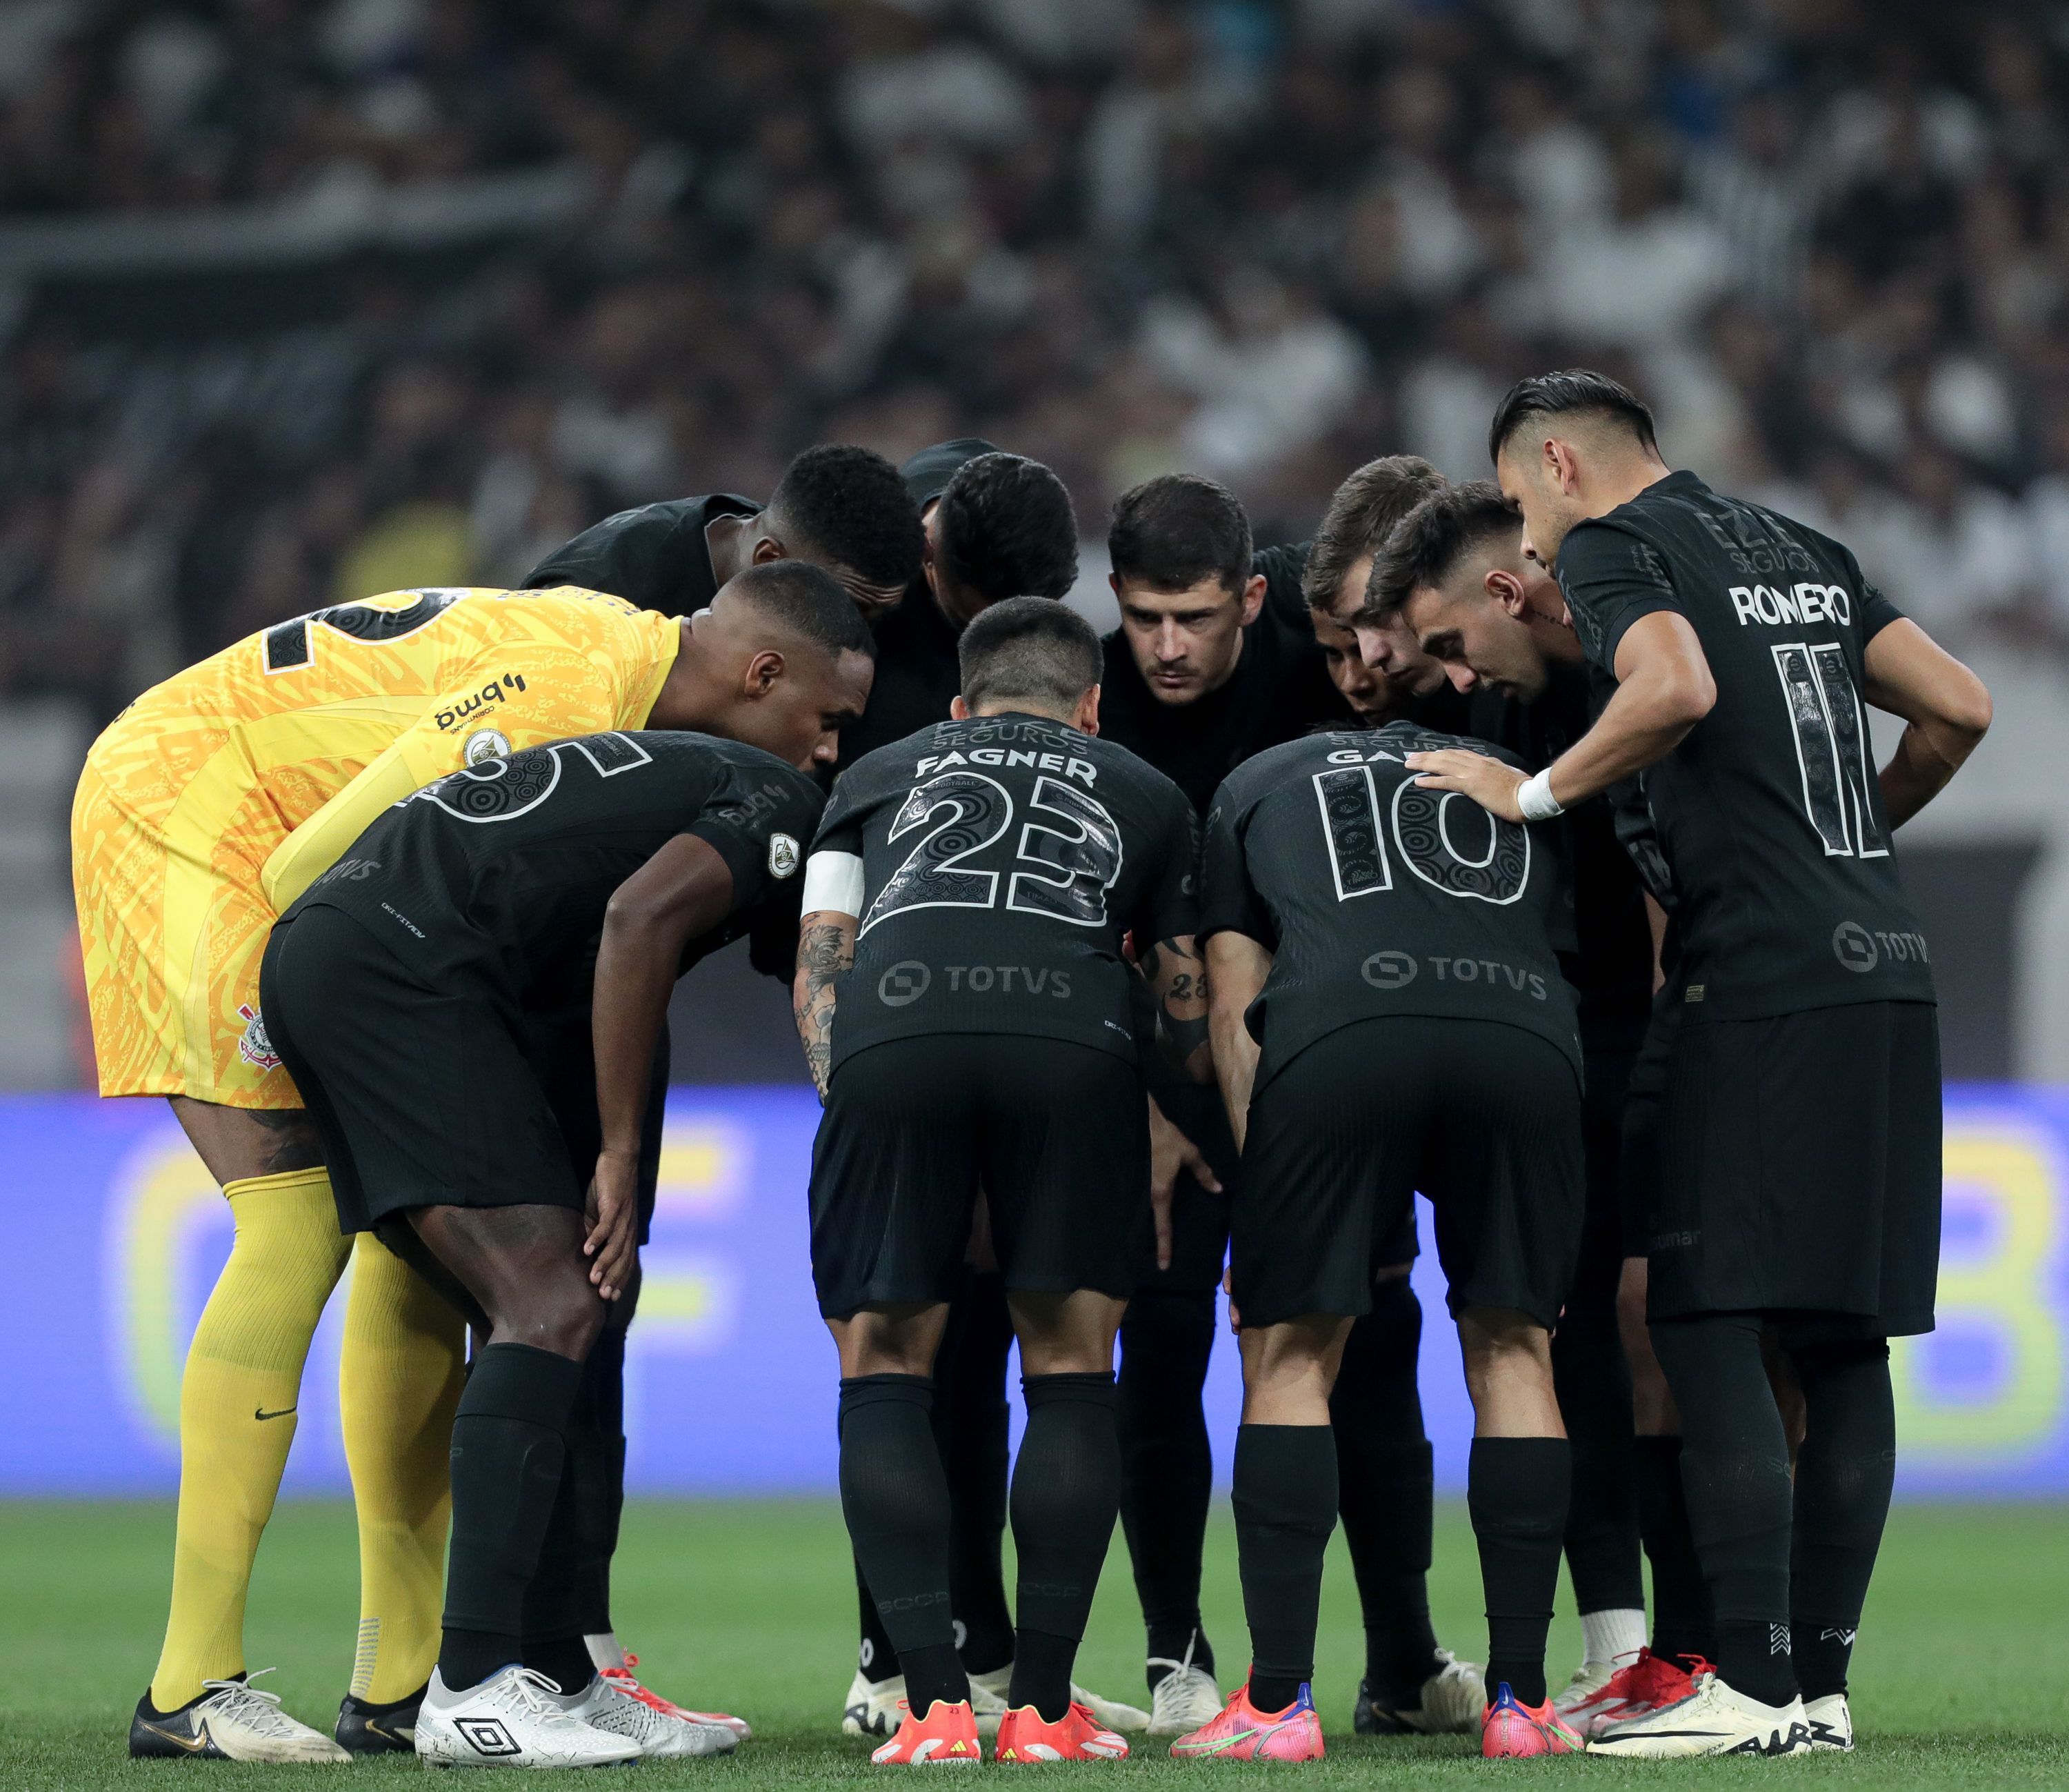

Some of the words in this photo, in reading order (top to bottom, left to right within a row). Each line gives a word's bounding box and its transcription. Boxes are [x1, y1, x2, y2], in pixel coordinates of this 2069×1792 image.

[1728, 583, 1850, 626] ROMERO
[434, 681, 506, 730] bmg
[931, 725, 1088, 755] SEGUROS
[1770, 642, 1890, 859] 11
[915, 748, 1098, 789] FAGNER
[855, 771, 1123, 941] 23
[1312, 765, 1530, 906] 10
[1875, 932, 1930, 965] TOTV
[944, 966, 1071, 999] TOTVS
[1428, 957, 1547, 1001] TOTVS
[949, 1706, 960, 1715] 23
